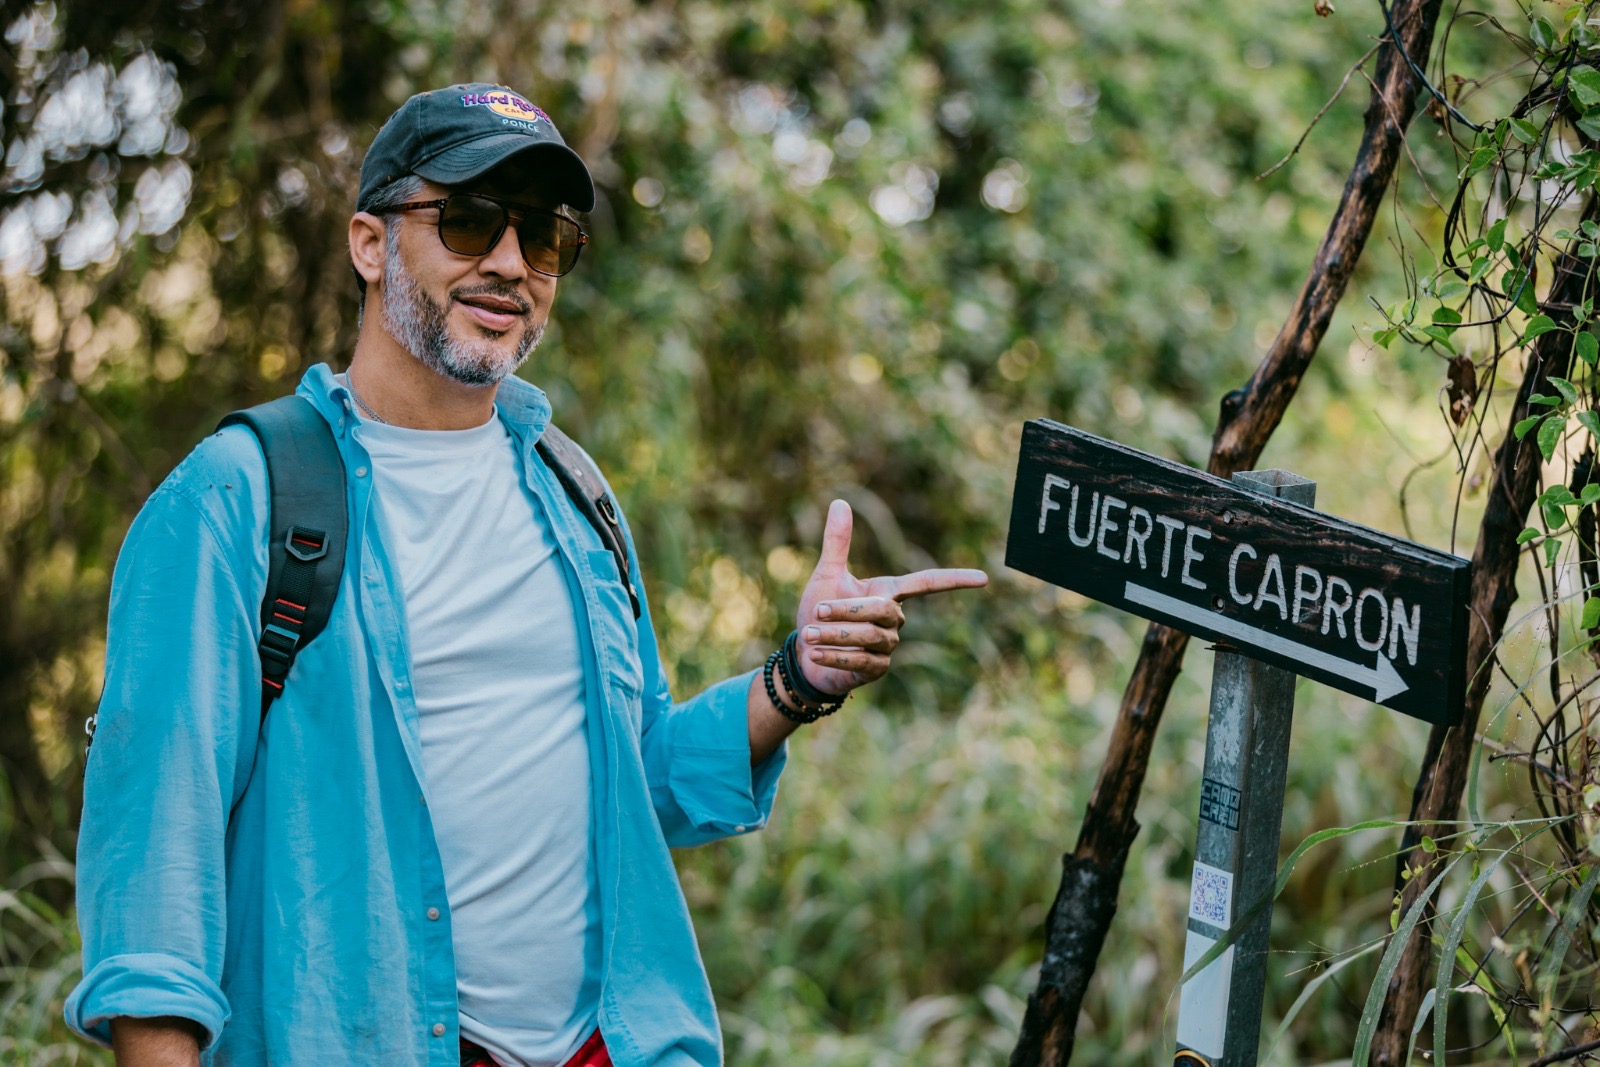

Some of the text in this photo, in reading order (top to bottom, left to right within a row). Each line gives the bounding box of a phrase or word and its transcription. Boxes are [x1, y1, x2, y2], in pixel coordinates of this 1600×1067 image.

[462, 93, 551, 124] Hard Rock
[502, 119, 540, 132] PONCE
[1038, 473, 1421, 666] FUERTE CAPRON
